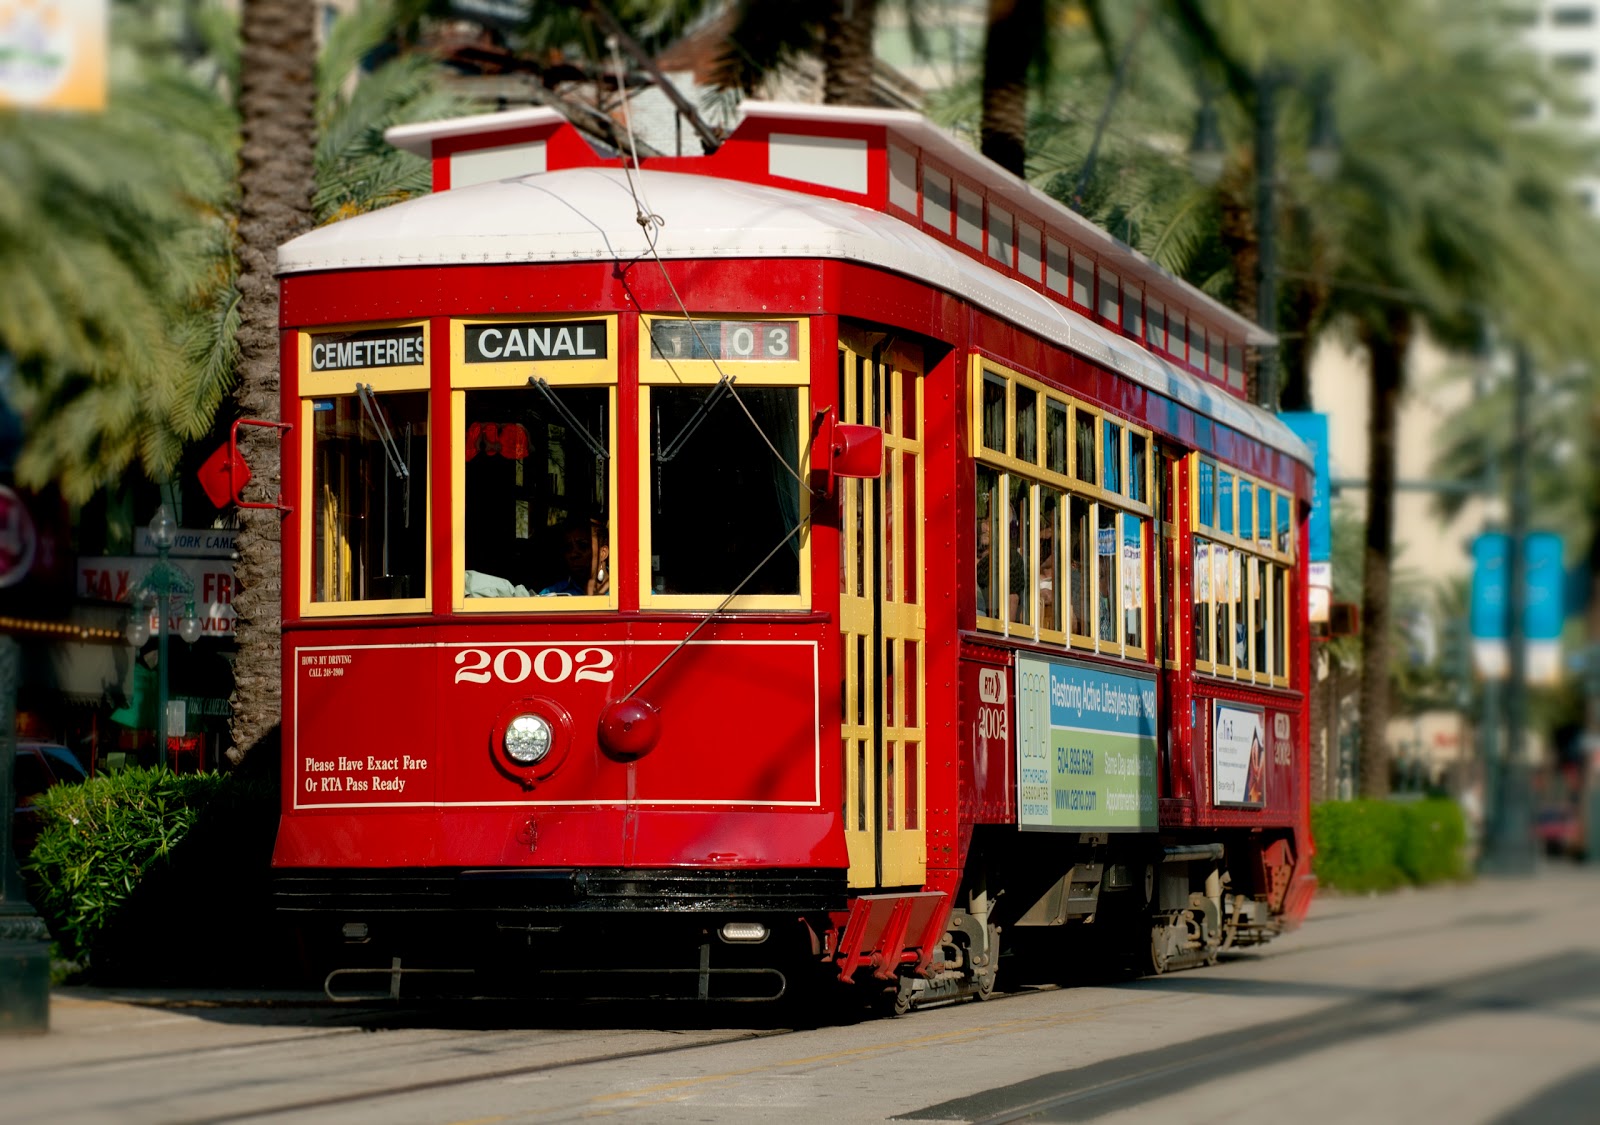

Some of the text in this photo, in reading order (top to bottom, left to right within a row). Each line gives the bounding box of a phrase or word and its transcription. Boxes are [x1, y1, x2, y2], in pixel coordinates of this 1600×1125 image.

[312, 336, 424, 370] CEMETERIES
[478, 327, 597, 358] CANAL
[174, 535, 201, 548] YORK
[83, 569, 239, 604] TAX FR
[301, 655, 352, 666] HOW'S MY DRIVING
[308, 668, 322, 677] CALL
[454, 648, 614, 684] 2002
[984, 677, 995, 696] RTA
[1051, 675, 1155, 721] Restoring Active Lifestyles since 1948
[978, 707, 1006, 740] 2002
[305, 755, 427, 772] Please Have Exact Fare
[1104, 751, 1117, 775] Same
[1117, 752, 1126, 781] Day
[1126, 754, 1135, 776] and
[305, 776, 405, 792] Or RTA Pass Ready
